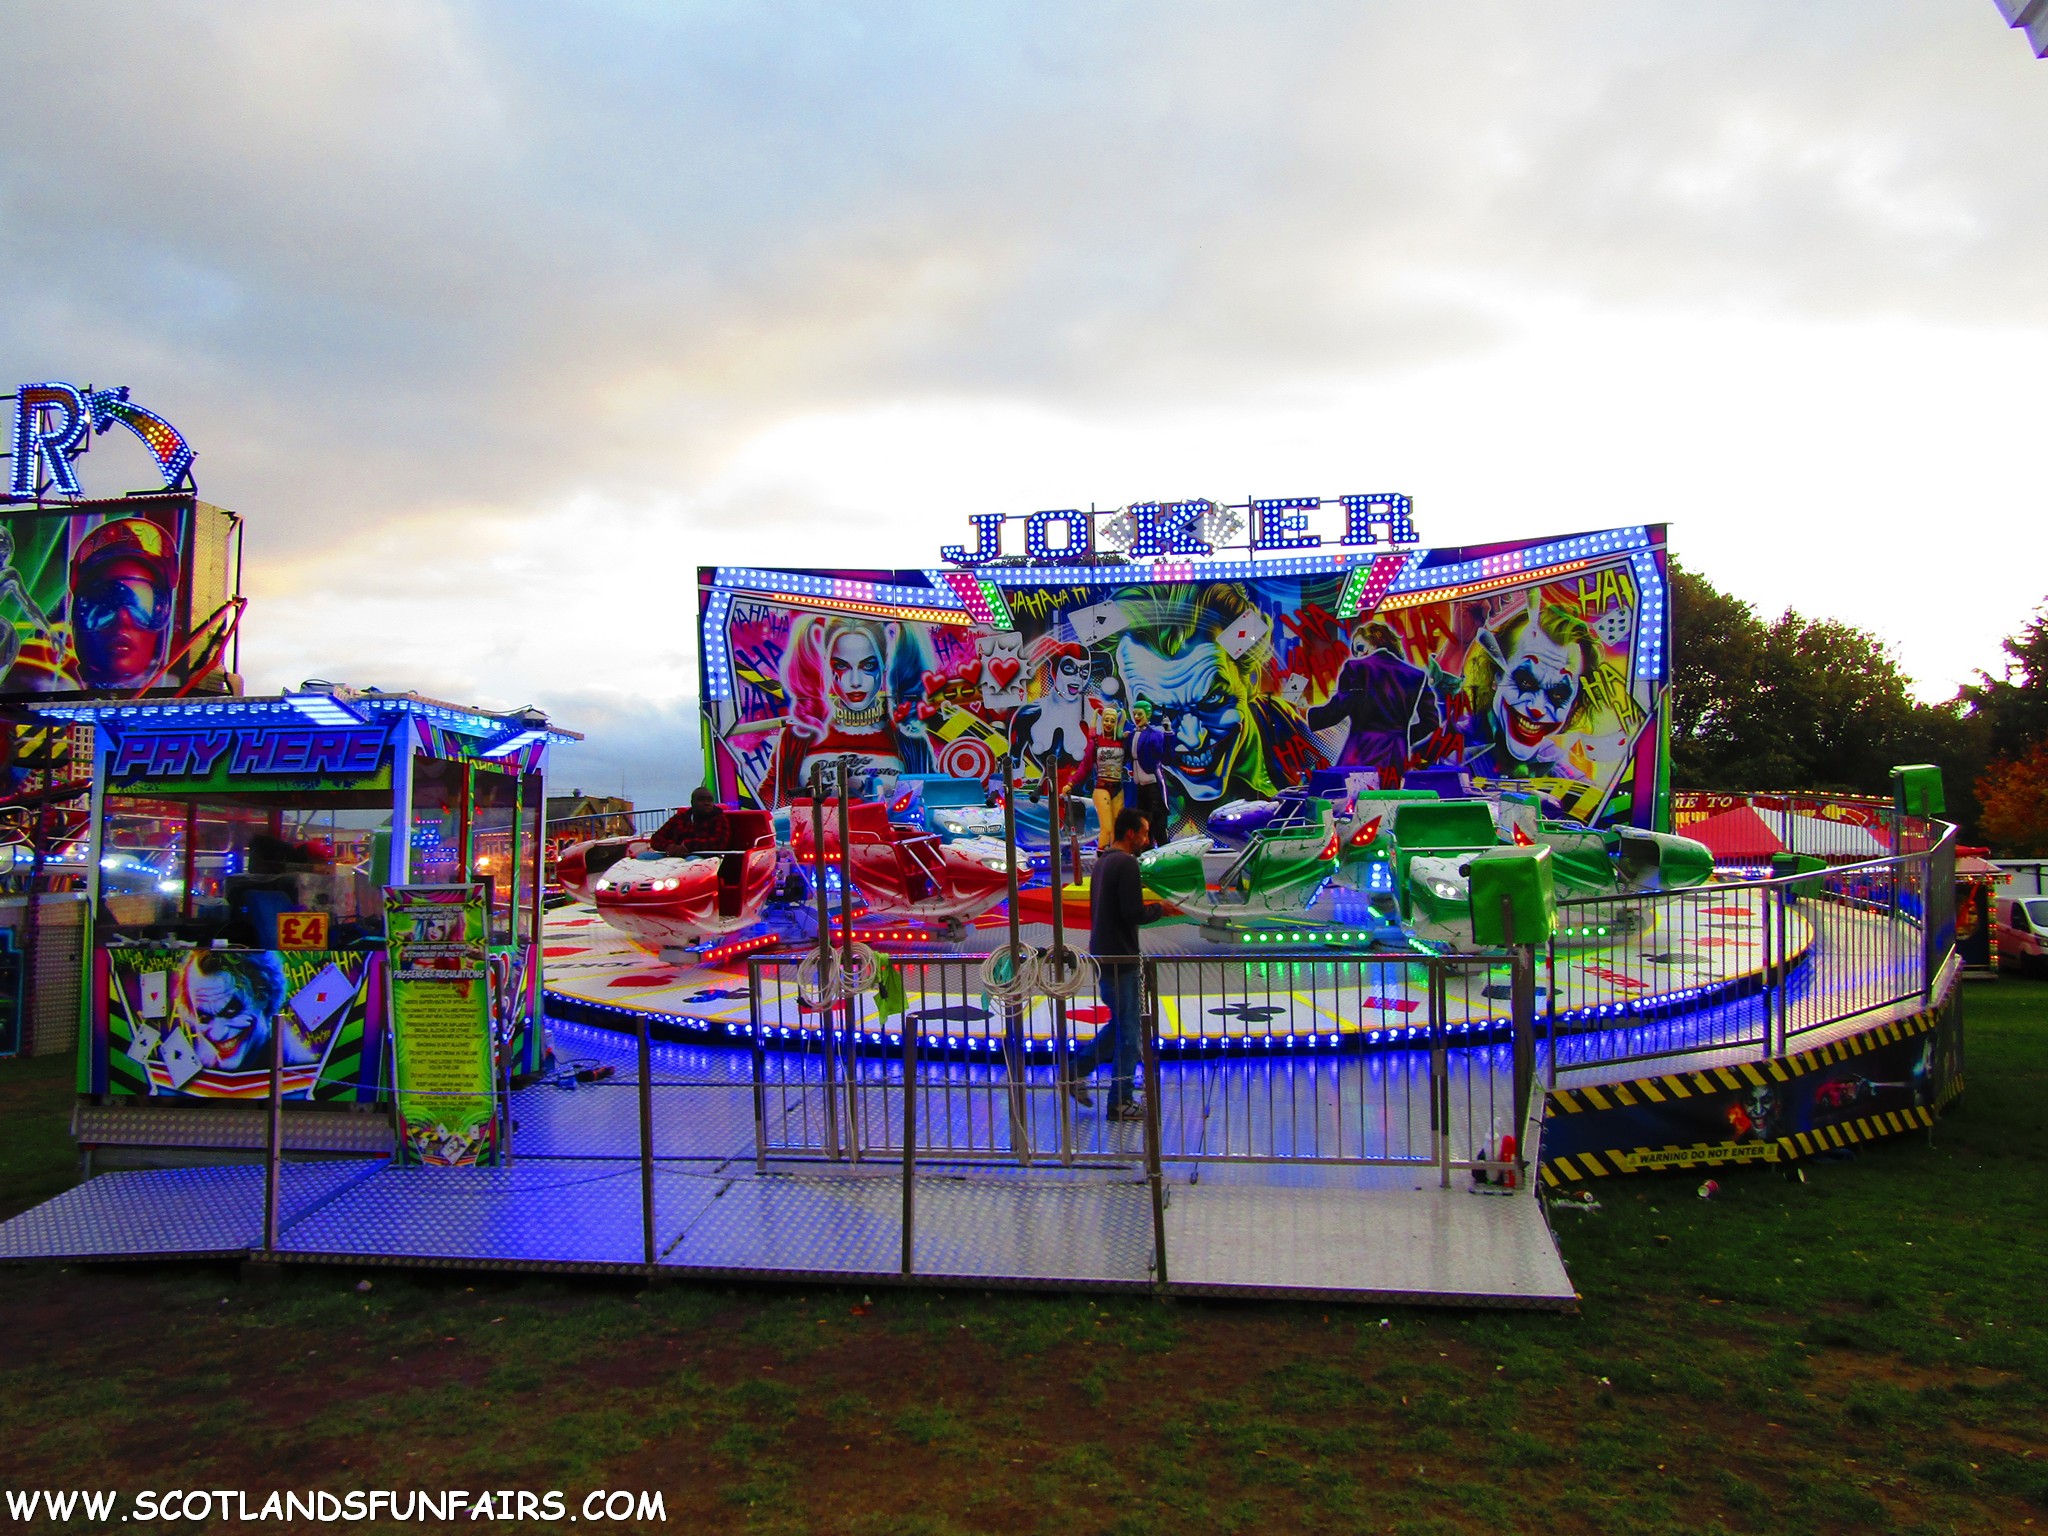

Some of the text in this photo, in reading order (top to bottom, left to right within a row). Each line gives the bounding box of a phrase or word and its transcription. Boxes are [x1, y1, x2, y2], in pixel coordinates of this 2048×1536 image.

[10, 382, 89, 499] R
[940, 493, 1420, 564] JOKER
[1580, 663, 1627, 712] HA
[111, 726, 388, 776] PAY HERE
[1707, 796, 1733, 808] TO
[282, 918, 324, 945] £4
[393, 969, 485, 980] PASSENGER REGULATIONS
[1640, 1146, 1765, 1164] WARNING DO NOT ENTER
